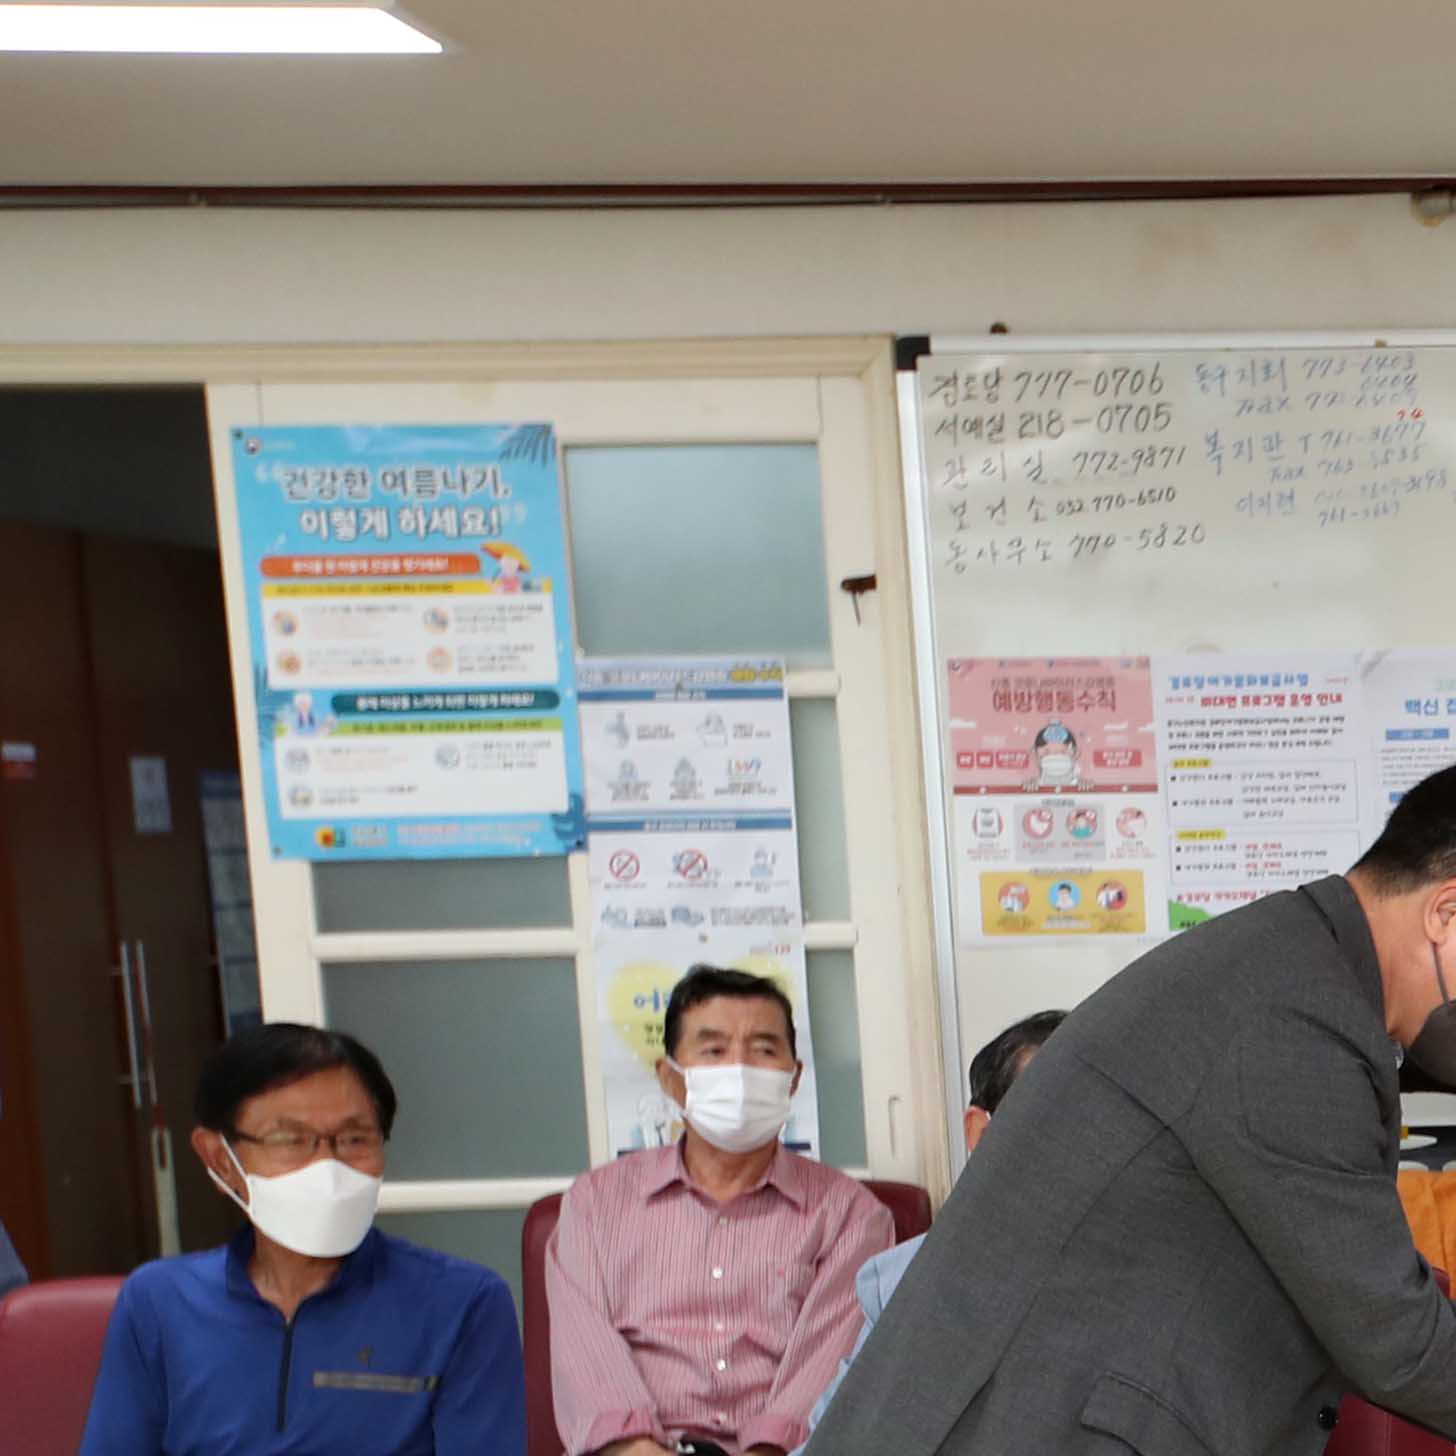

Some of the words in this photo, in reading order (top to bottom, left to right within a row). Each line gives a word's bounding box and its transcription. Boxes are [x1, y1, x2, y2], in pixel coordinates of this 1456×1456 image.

[1014, 362, 1164, 401] 777-0706
[1019, 402, 1172, 439] 218-0705
[1073, 446, 1187, 474] 772-9871
[302, 507, 389, 540] 이렇게
[400, 506, 498, 537] 하세요!
